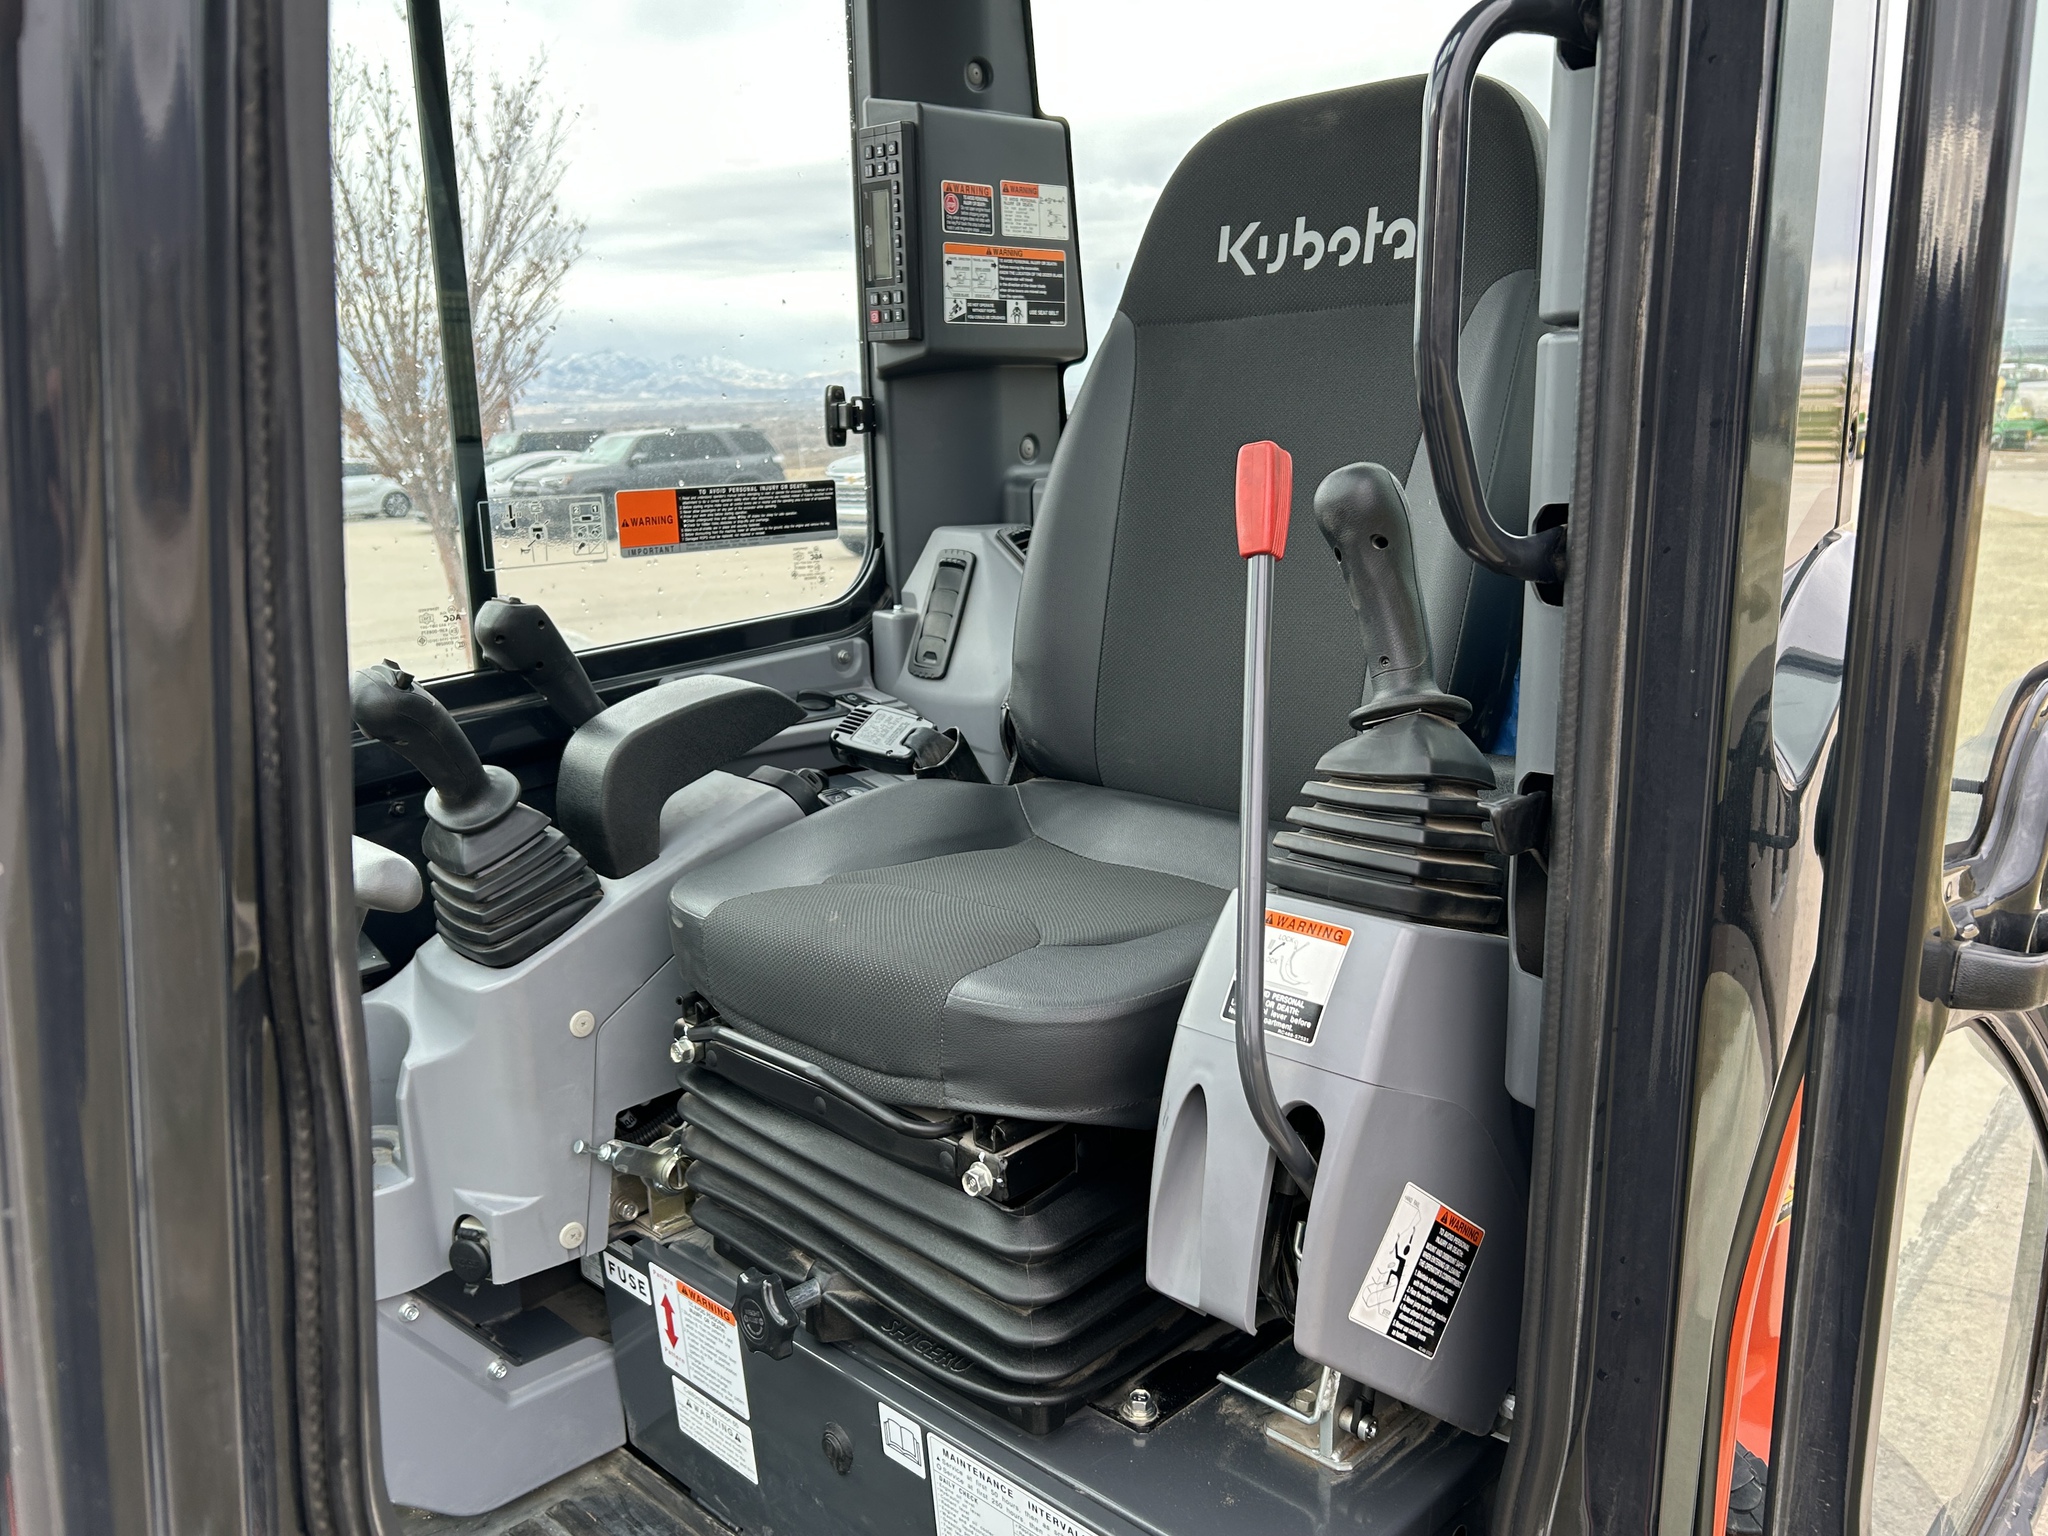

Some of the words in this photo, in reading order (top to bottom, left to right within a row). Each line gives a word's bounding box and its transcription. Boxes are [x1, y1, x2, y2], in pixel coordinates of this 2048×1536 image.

[953, 185, 990, 196] WARNING
[1009, 186, 1038, 195] WARNING
[993, 248, 1024, 258] WARNING
[1218, 206, 1416, 275] Kubota
[630, 515, 674, 527] WARNING
[628, 545, 675, 556] IMPORTANT
[1276, 916, 1344, 942] WARNING
[1265, 1000, 1275, 1008] OR
[1272, 993, 1305, 1009] PERSONAL
[1271, 1010, 1287, 1020] lever
[1290, 1015, 1311, 1028] before
[1448, 1216, 1480, 1242] WARNING
[608, 1260, 647, 1297] FUSE
[688, 1290, 730, 1321] WARNING
[694, 1407, 733, 1437] WARNING
[943, 1448, 1014, 1499] MAINTENANCE
[939, 1475, 955, 1489] DAILY
[959, 1488, 978, 1504] CHECK
[942, 1467, 964, 1484] Service
[976, 1488, 988, 1500] first
[991, 1498, 1003, 1509] 250
[942, 1458, 963, 1476] Service
[975, 1479, 987, 1491] first
[991, 1489, 999, 1498] 50
[1025, 1510, 1039, 1523] then
